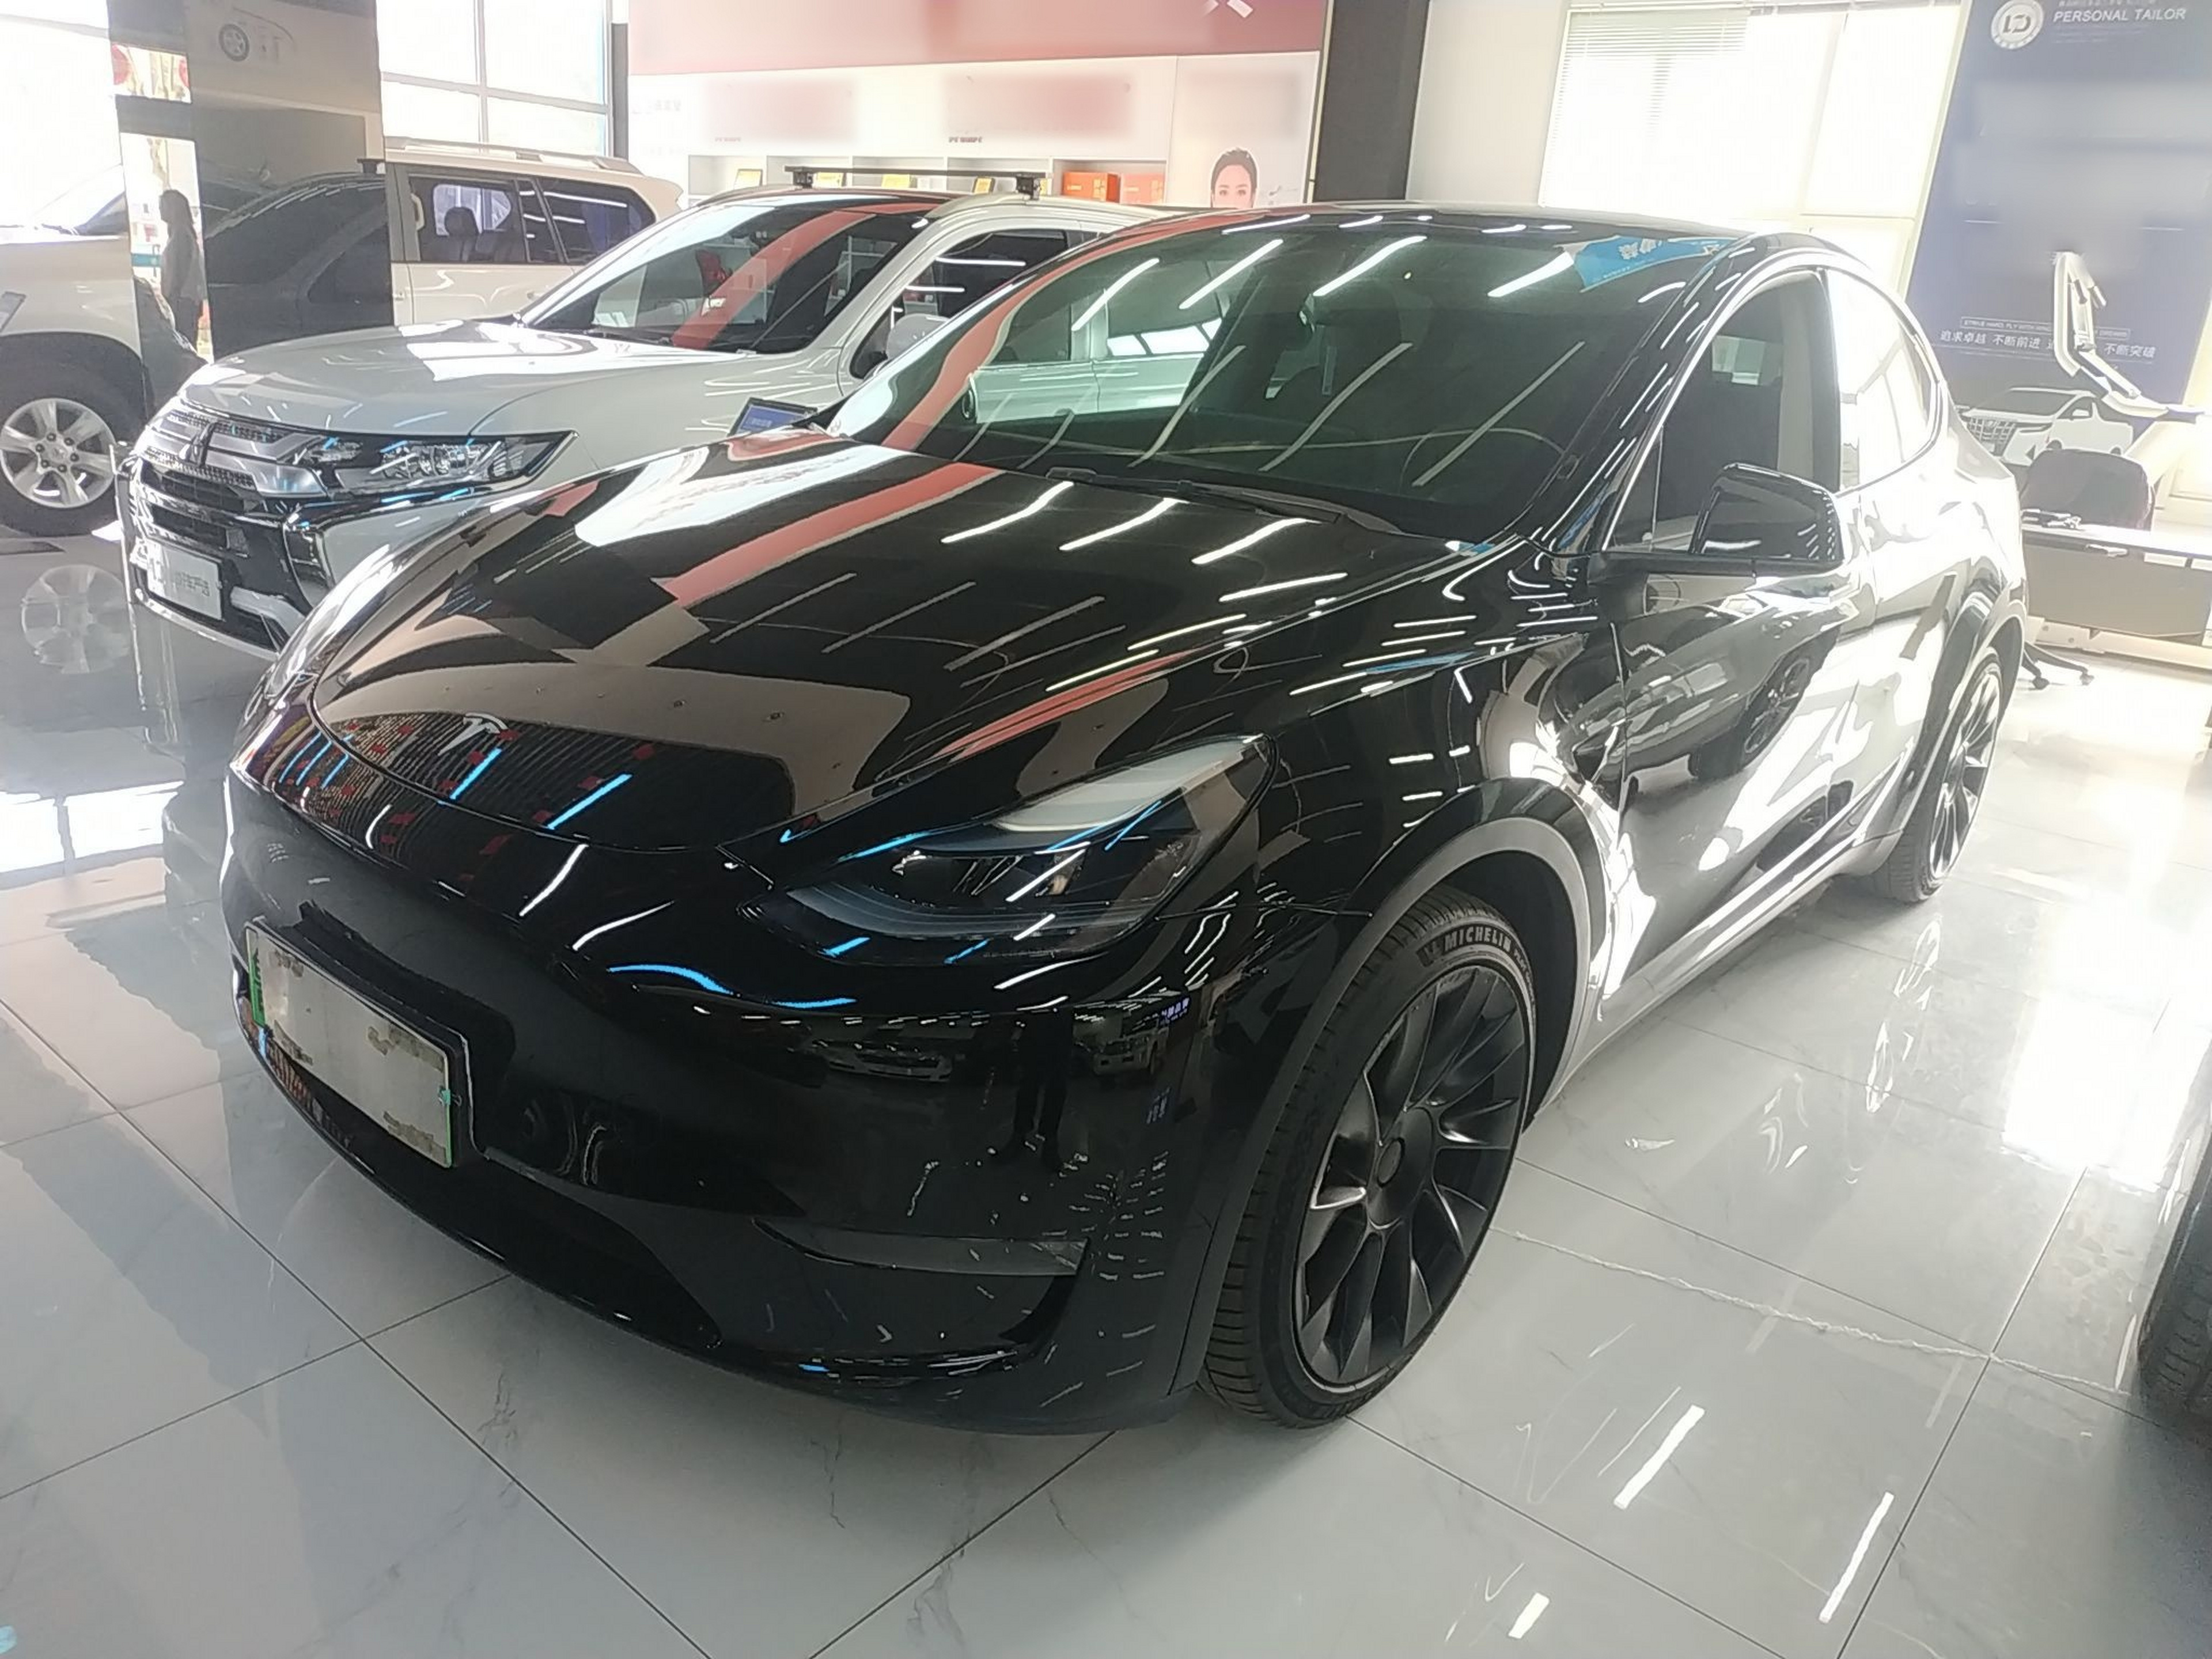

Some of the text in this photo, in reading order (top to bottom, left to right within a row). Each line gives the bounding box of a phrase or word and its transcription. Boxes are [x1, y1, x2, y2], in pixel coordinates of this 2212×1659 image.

[2053, 8, 2187, 22] PERSONAL TAILOR
[1940, 330, 1987, 344] 追求卓越
[1993, 334, 2041, 349] 不断前进
[2104, 343, 2156, 358] 不断突破
[1445, 926, 1512, 952] MICHELIN
